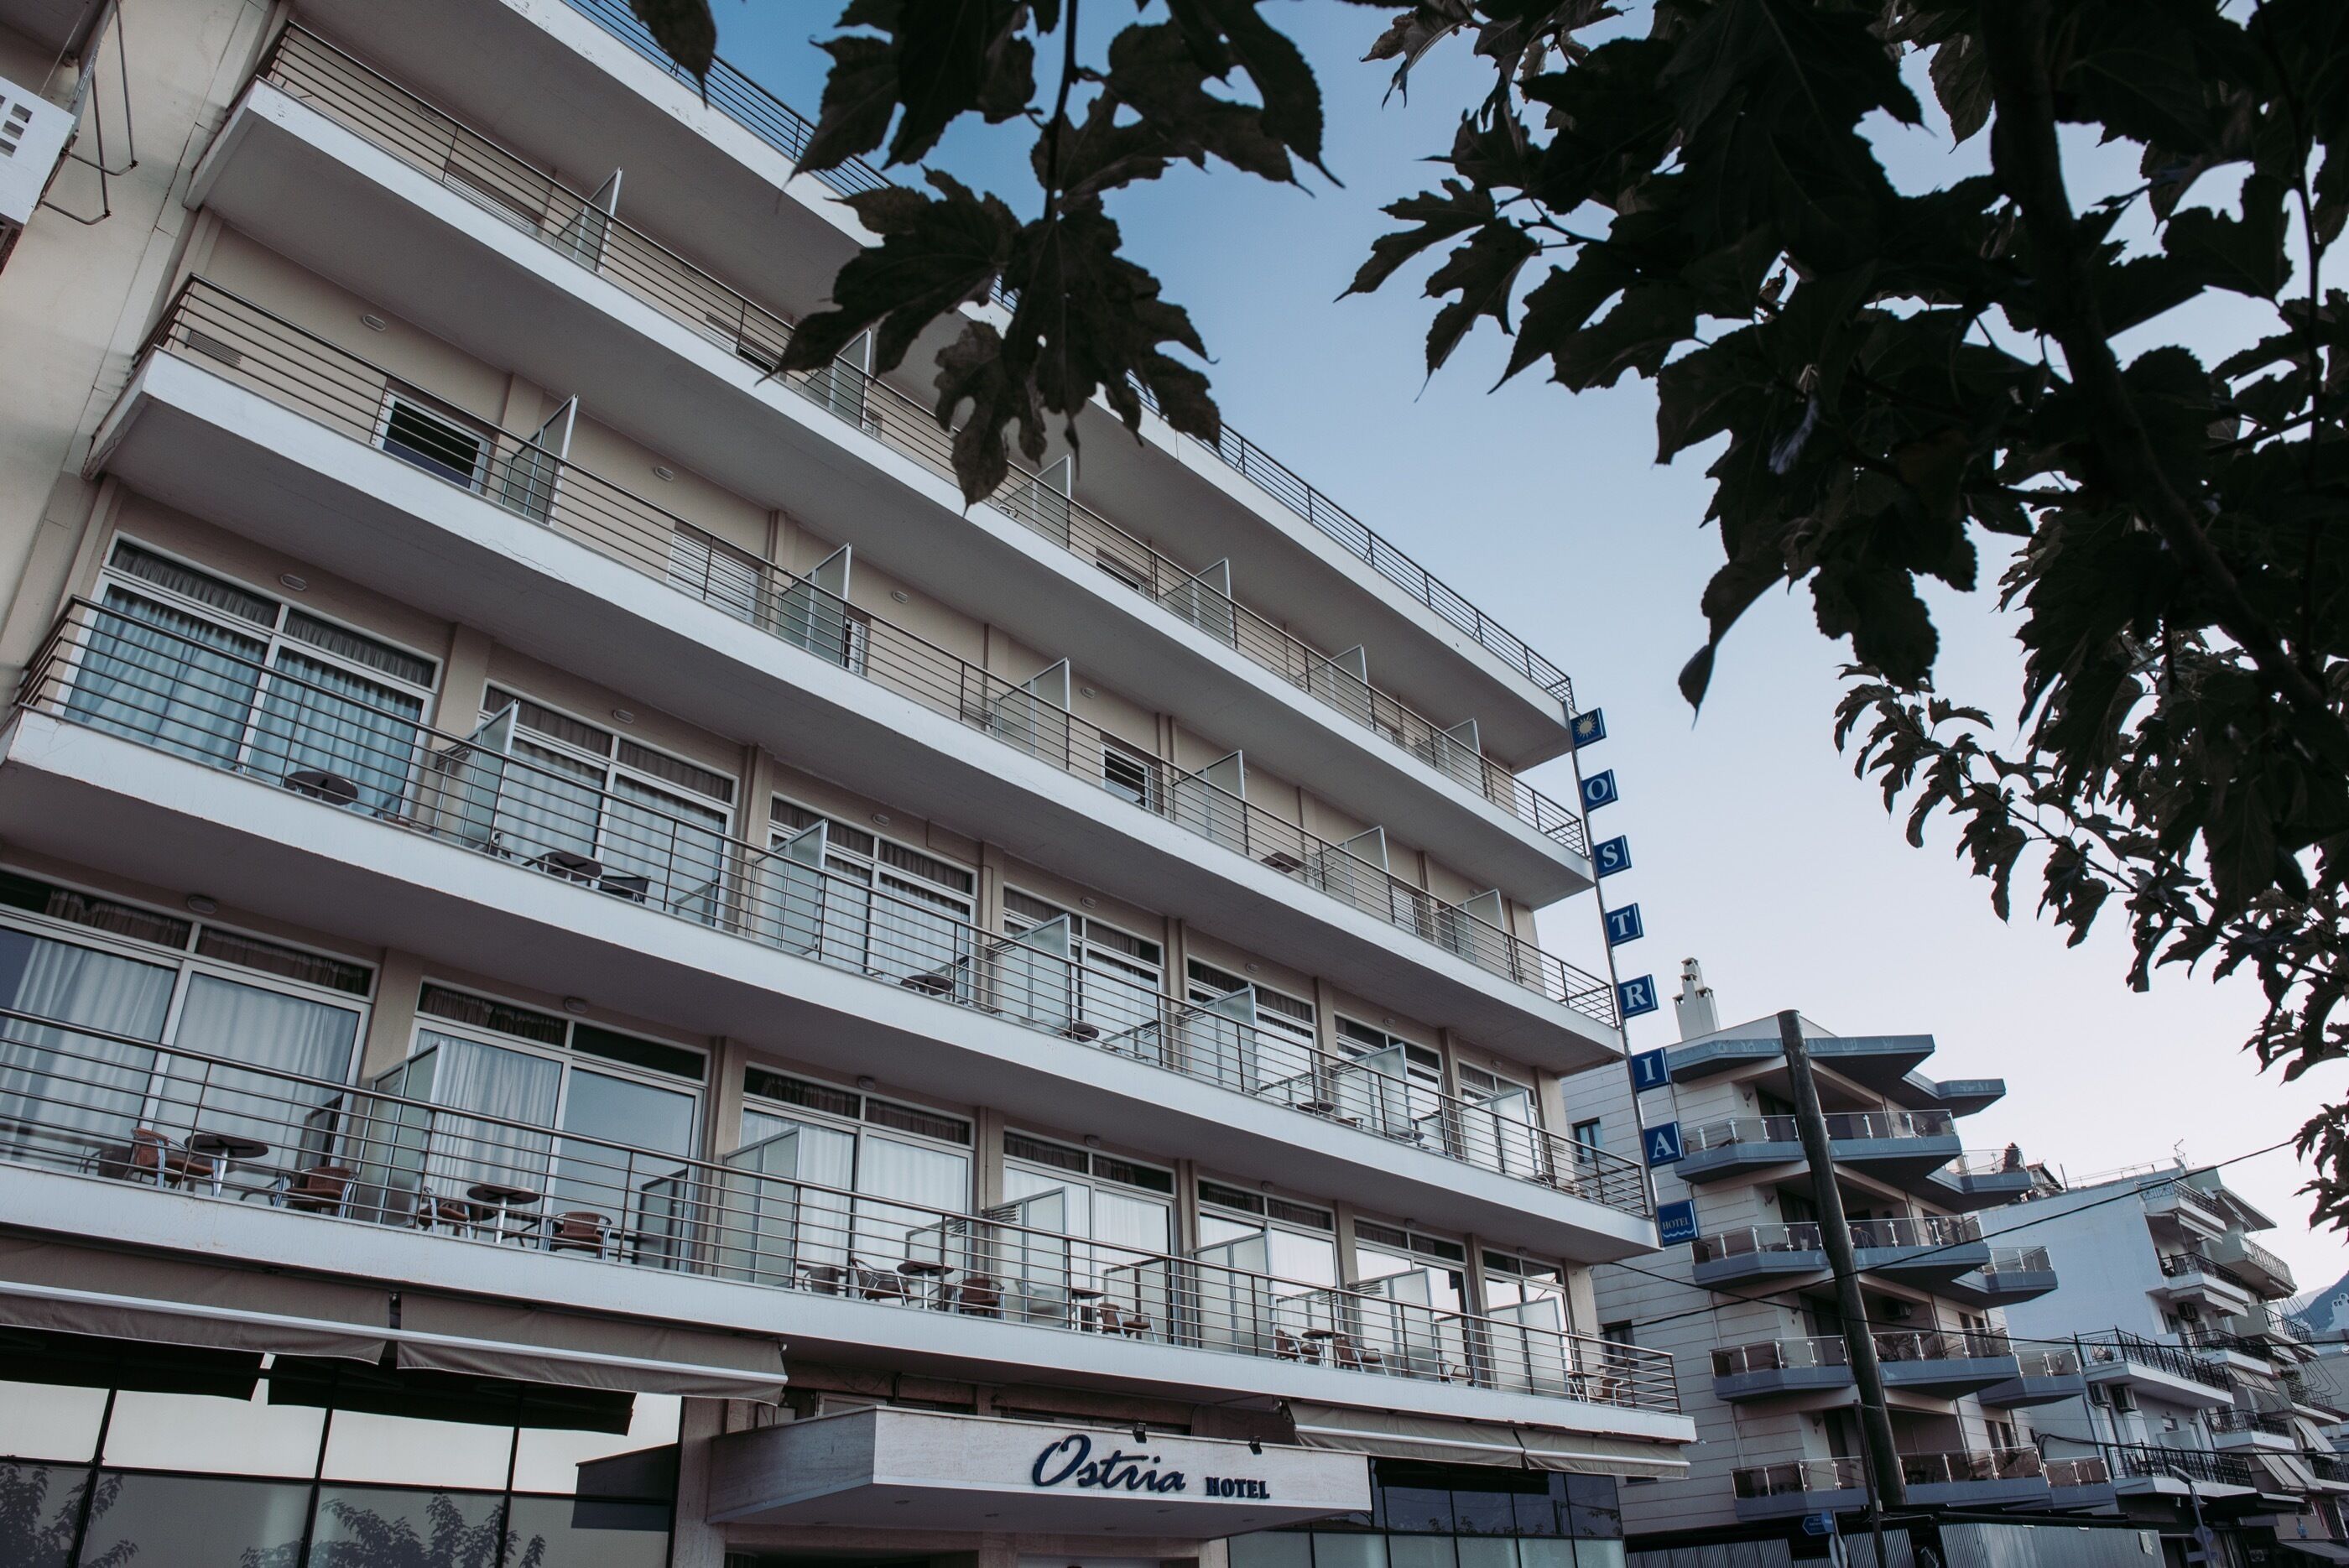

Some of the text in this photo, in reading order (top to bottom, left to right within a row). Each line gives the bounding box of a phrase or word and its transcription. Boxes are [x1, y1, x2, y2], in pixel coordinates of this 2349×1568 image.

[1586, 778, 1676, 1159] OSTRIA
[1662, 1216, 1690, 1231] HOTEL
[1033, 1433, 1270, 1499] Ostria HOTEL
